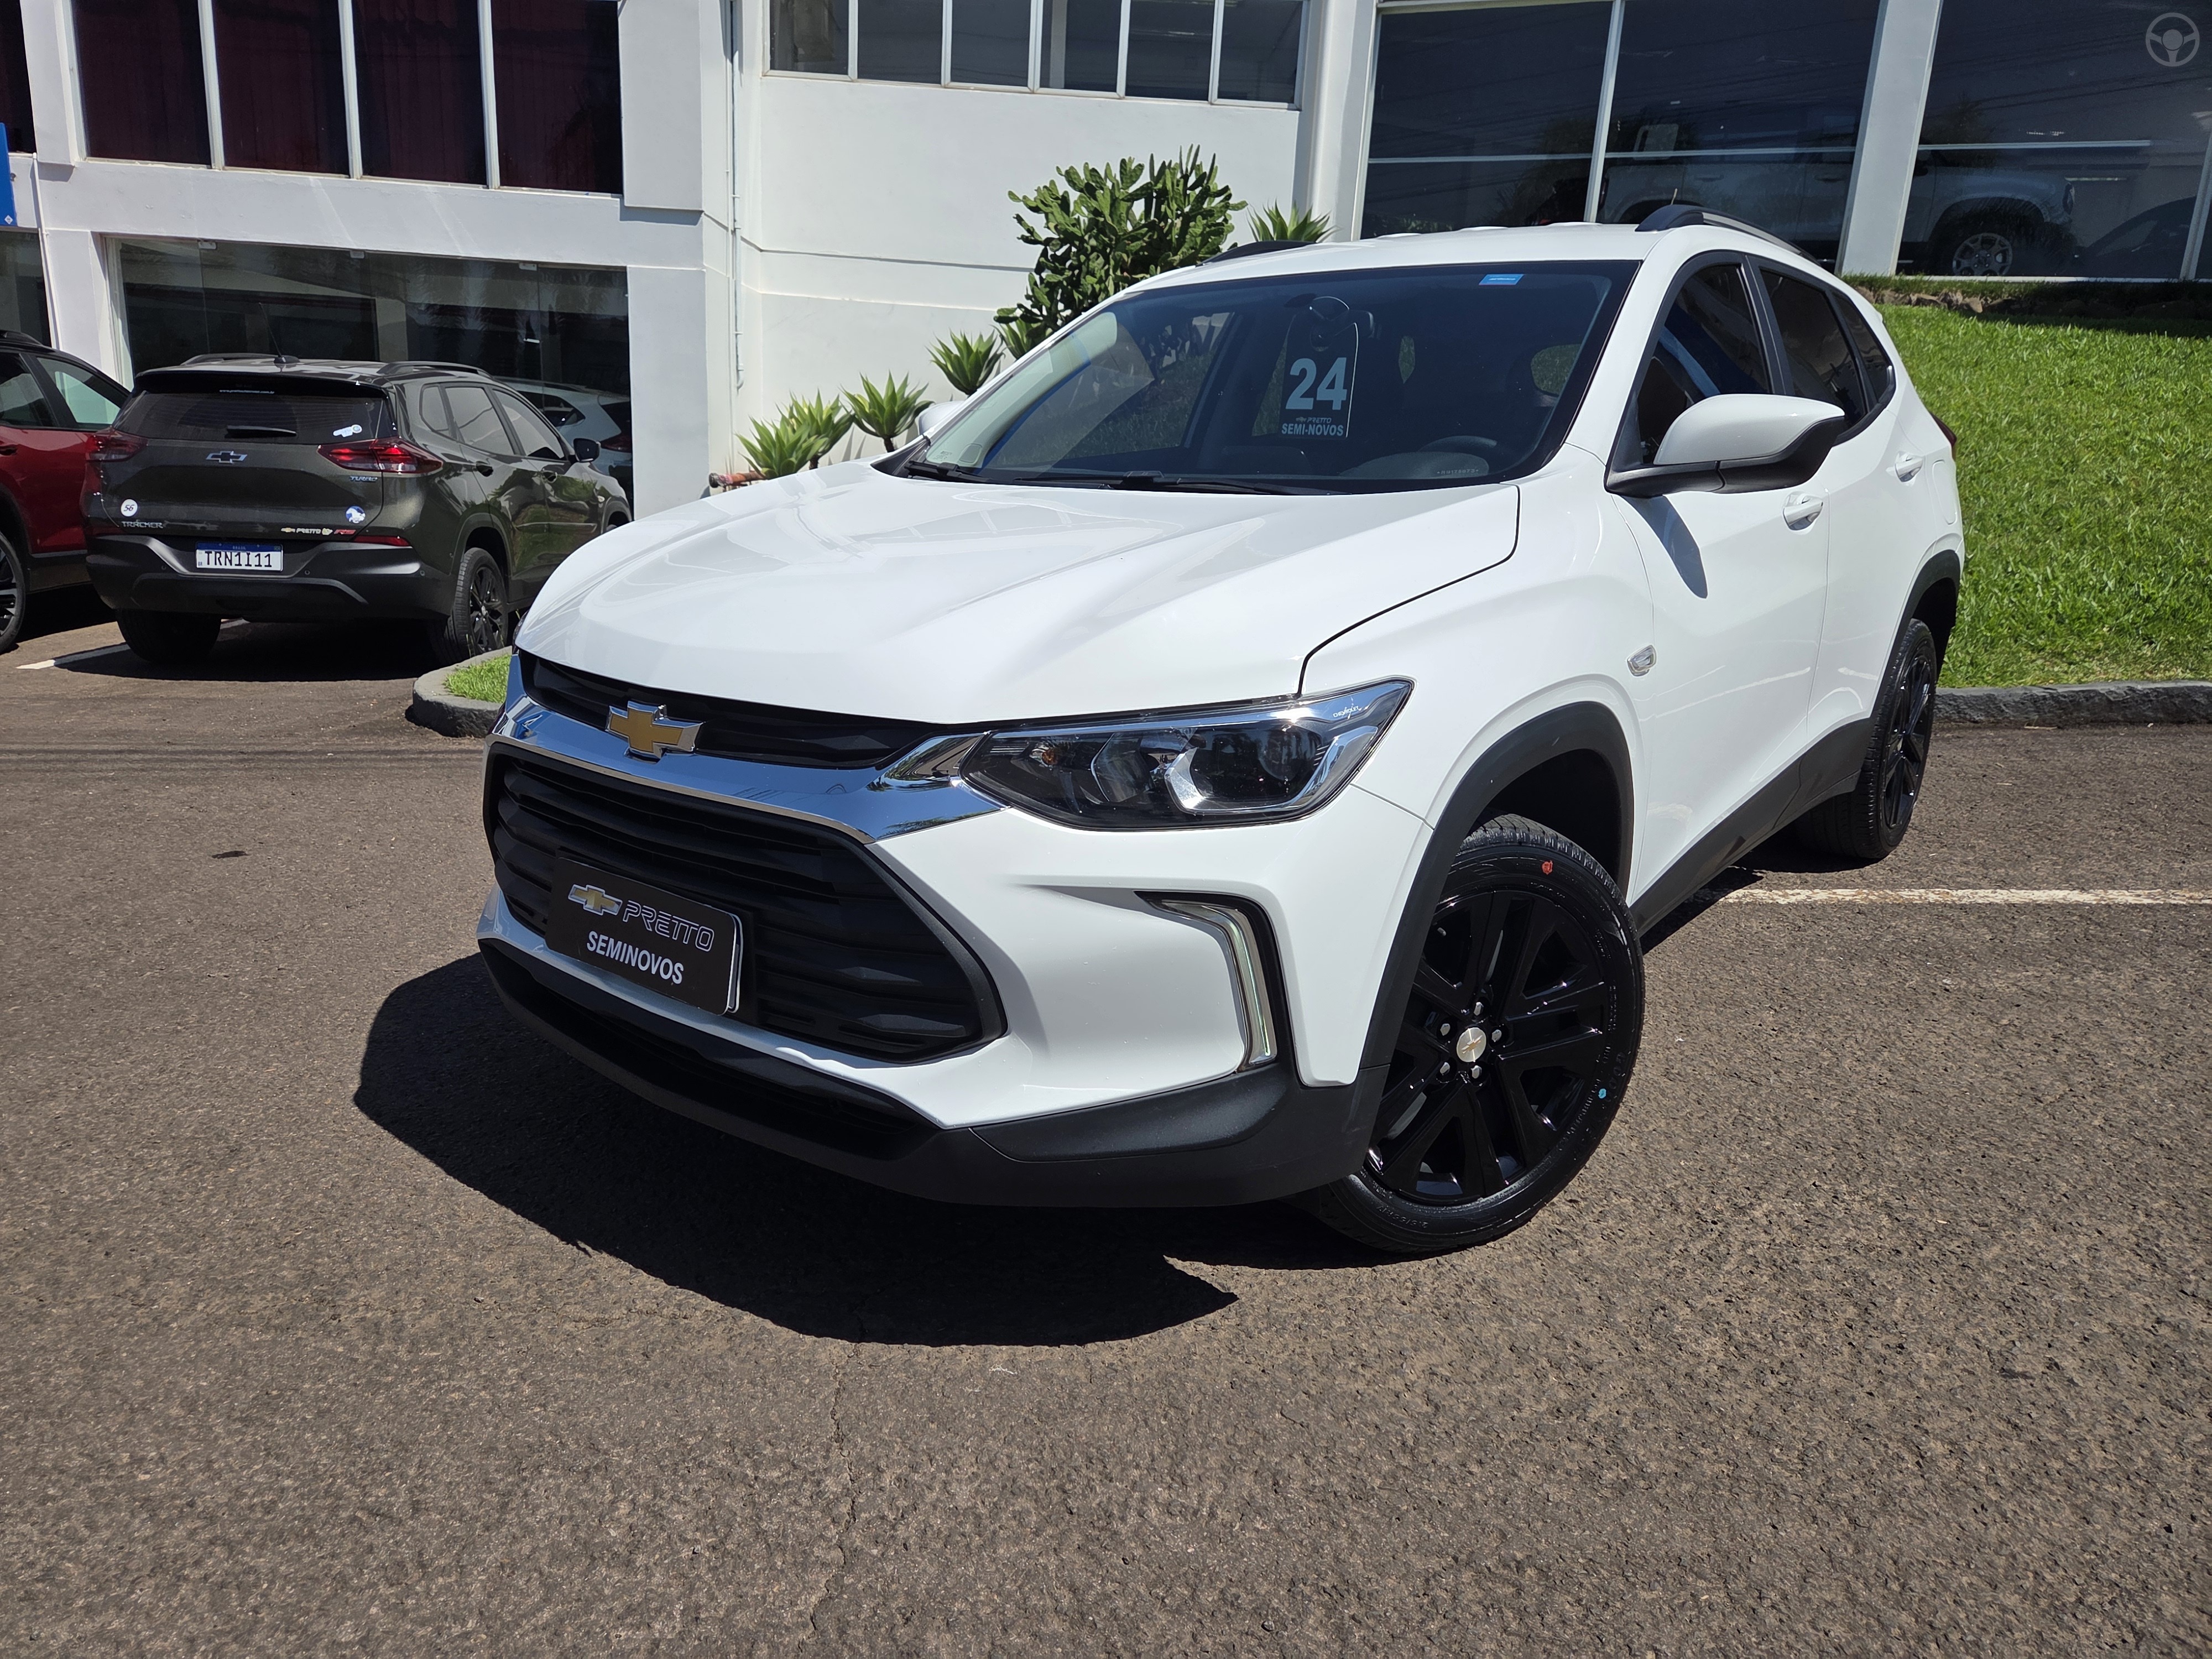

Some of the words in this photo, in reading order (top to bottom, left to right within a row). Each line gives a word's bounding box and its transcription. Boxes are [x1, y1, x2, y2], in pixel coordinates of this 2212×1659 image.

[1285, 357, 1347, 410] 24
[1281, 423, 1344, 436] SEMI-NOVOS
[123, 504, 135, 512] 56
[205, 551, 272, 567] TRN1I11
[1333, 706, 1359, 717] CHEVROLET
[622, 900, 714, 952] PRETTO
[587, 931, 684, 984] SEMINOVOS
